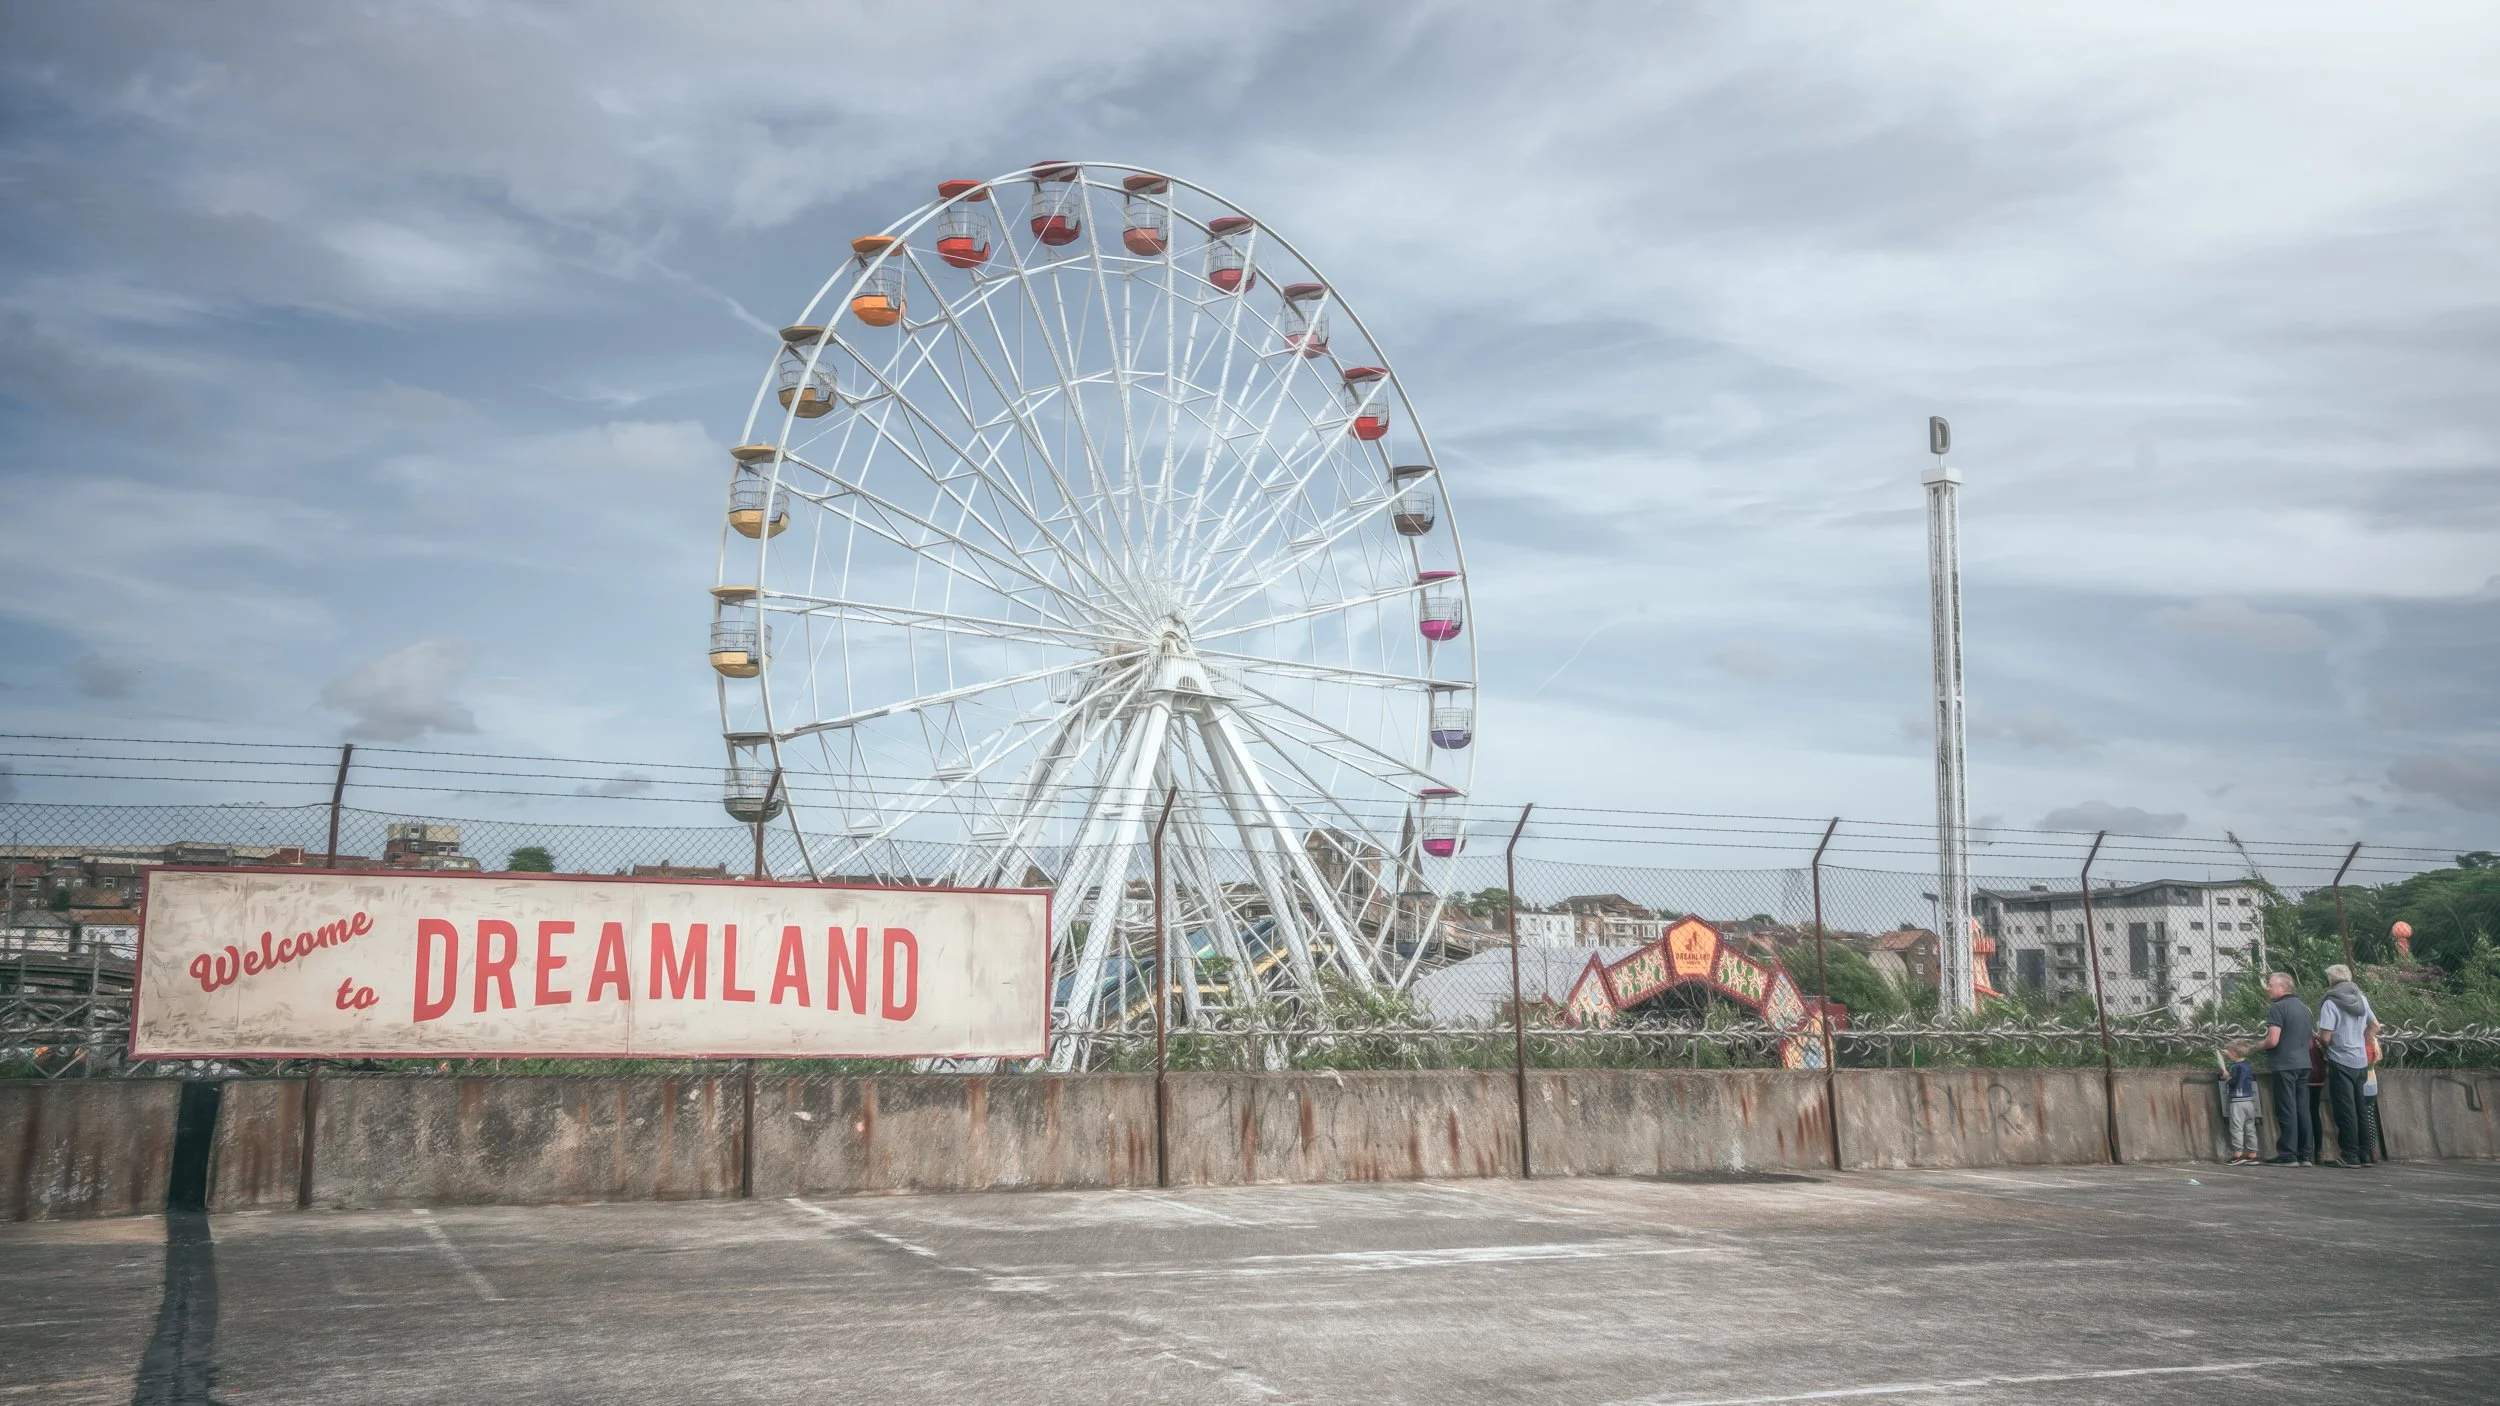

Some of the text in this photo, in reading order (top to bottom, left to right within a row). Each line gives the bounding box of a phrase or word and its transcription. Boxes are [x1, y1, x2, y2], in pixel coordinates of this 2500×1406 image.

[1929, 416, 1950, 454] D
[190, 911, 374, 993] Welcome
[413, 918, 919, 1024] DREAMLAND
[335, 977, 380, 1011] to
